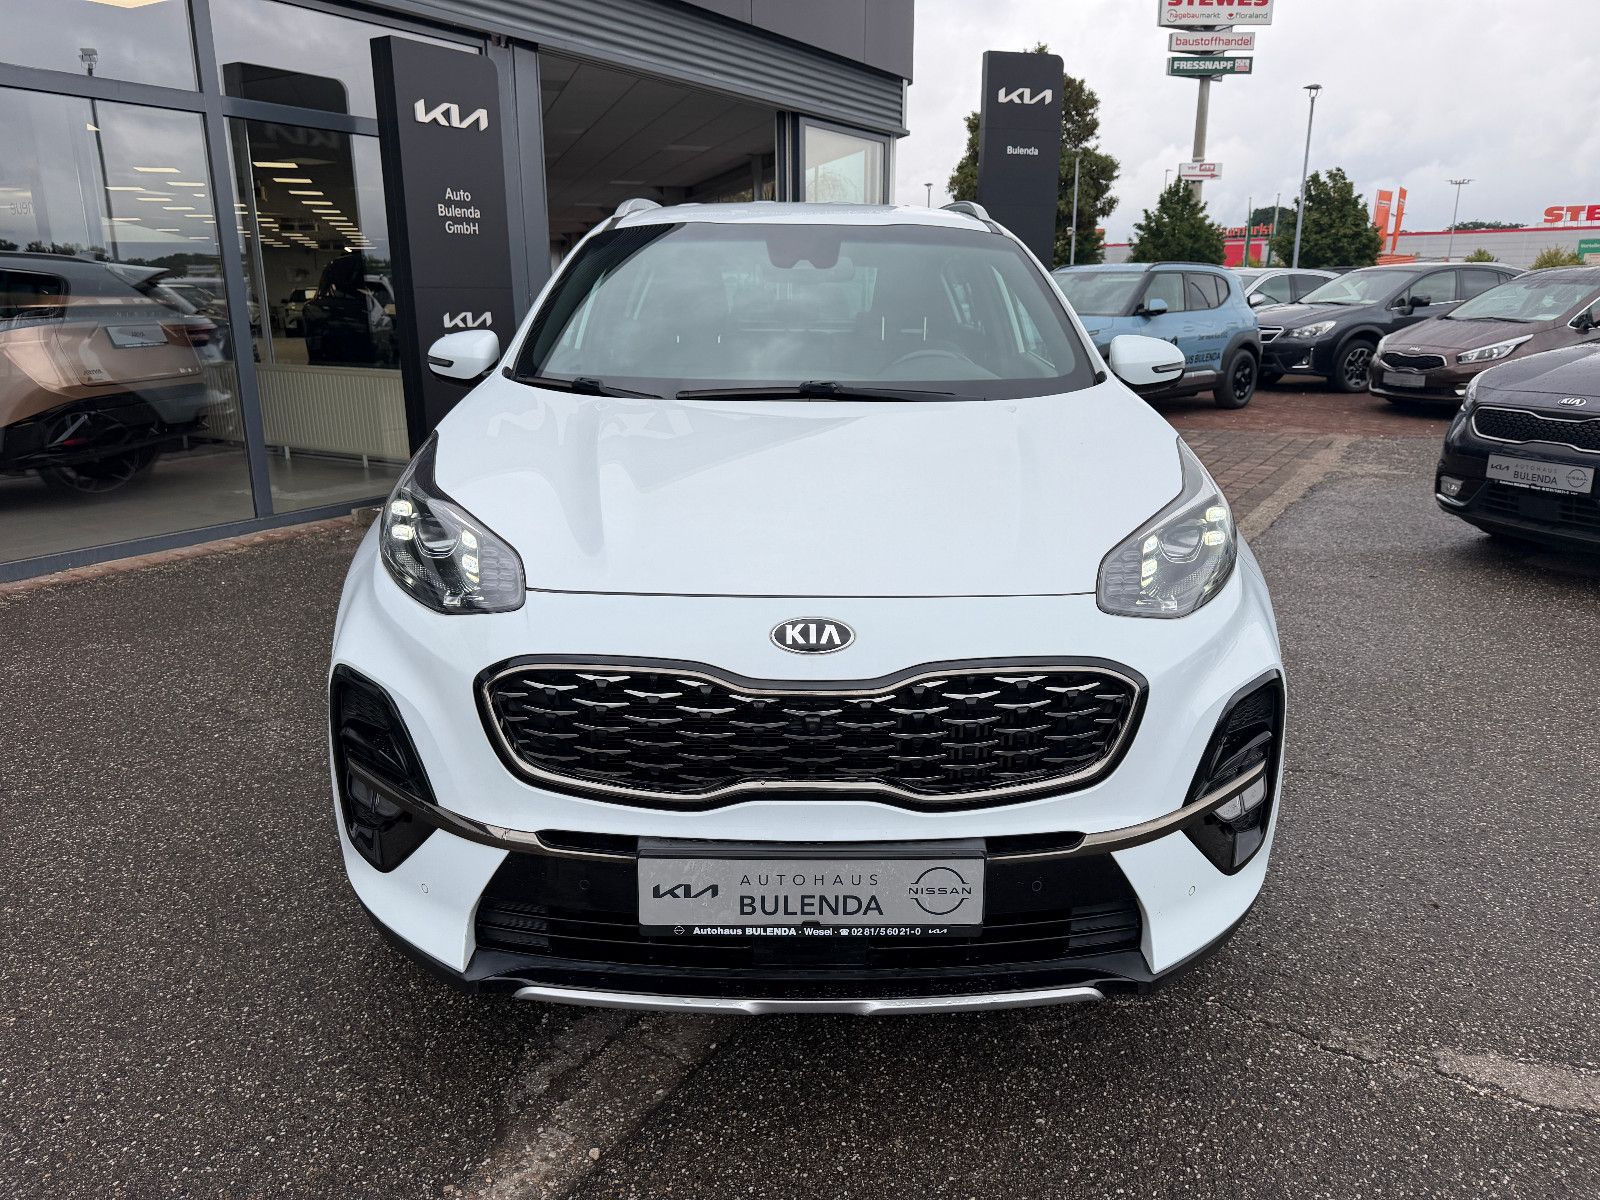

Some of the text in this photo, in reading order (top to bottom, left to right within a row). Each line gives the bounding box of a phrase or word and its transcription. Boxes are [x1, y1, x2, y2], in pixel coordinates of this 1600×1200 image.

[1175, 37, 1252, 46] baustoffhandel
[1173, 60, 1234, 70] FRESSNAPF
[998, 86, 1053, 106] KIA
[414, 99, 489, 131] KIA
[1006, 145, 1039, 156] Bulenda
[445, 187, 472, 202] Auto
[437, 204, 481, 218] Bulenda
[445, 220, 479, 235] GmbH
[443, 311, 493, 329] KIA
[1513, 471, 1558, 485] BULENDA
[785, 623, 842, 645] KIA
[739, 874, 879, 886] AUTOHAUS
[652, 883, 972, 916] KIA BULENDA NISSAN
[693, 927, 743, 936] Autohaus
[745, 927, 797, 936] BULENDA
[803, 927, 833, 936] Wesel
